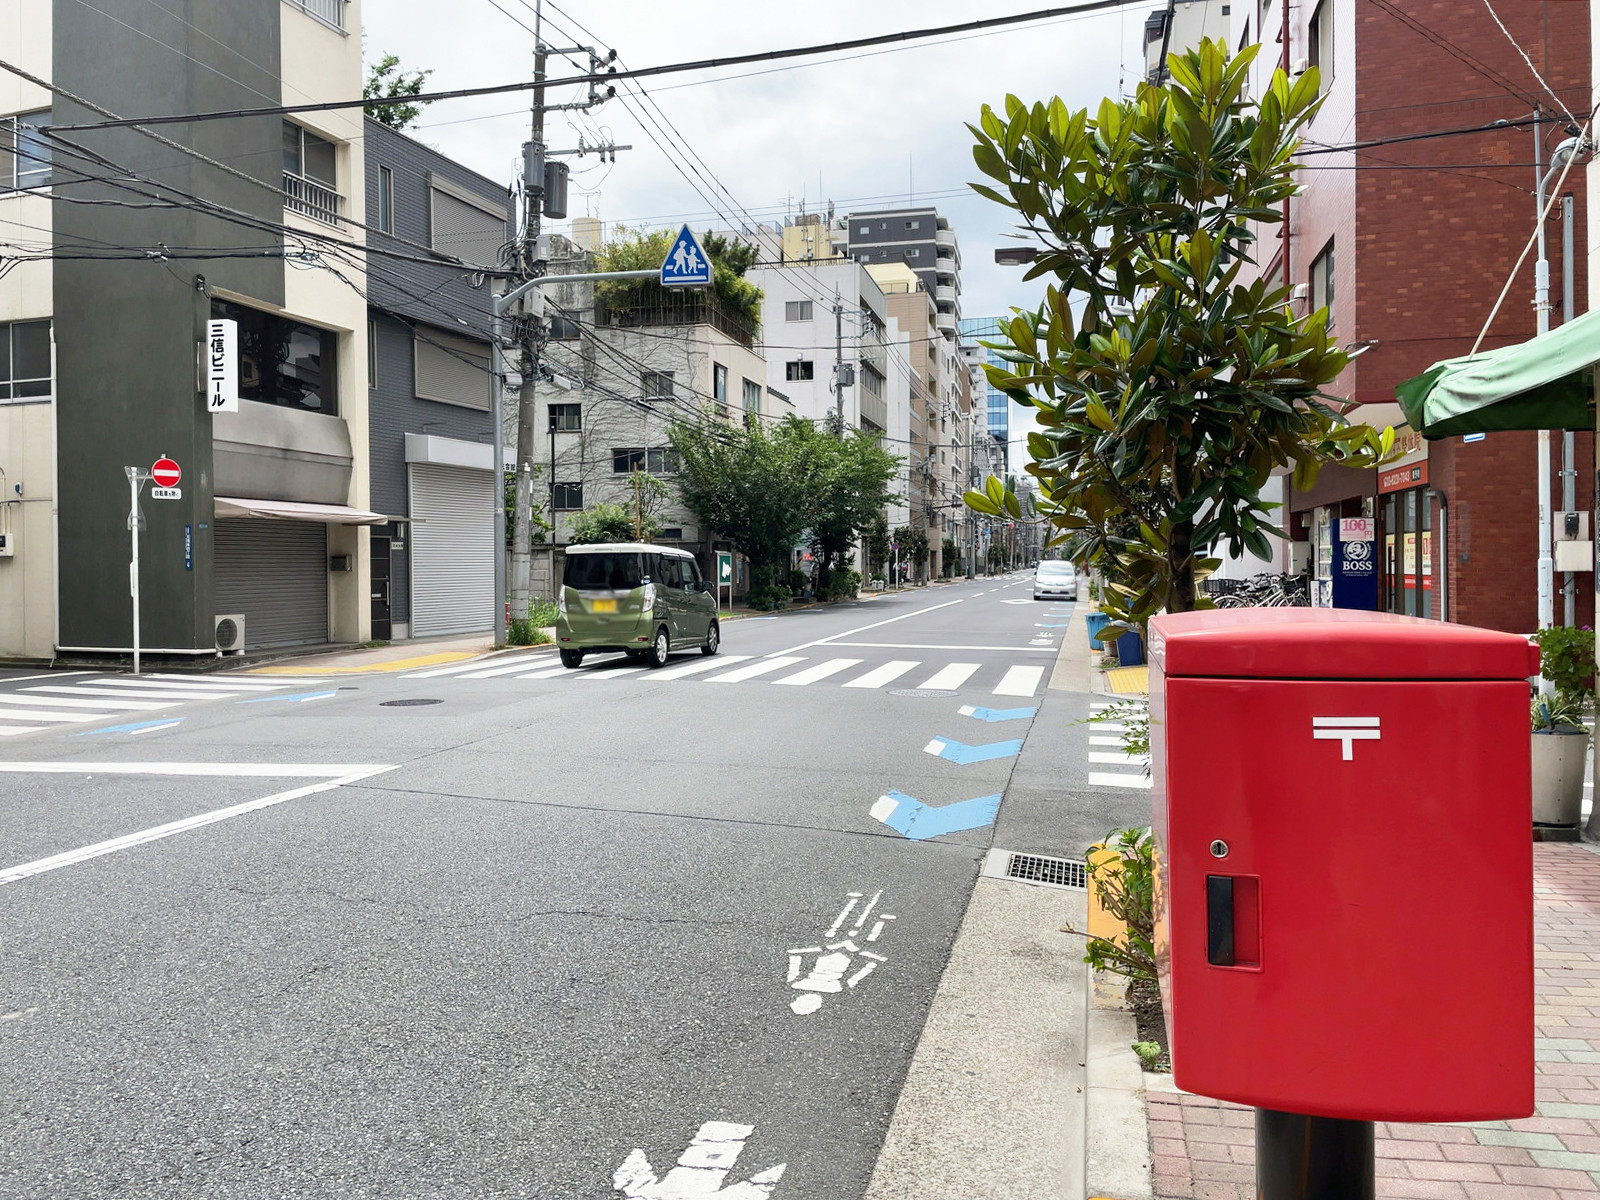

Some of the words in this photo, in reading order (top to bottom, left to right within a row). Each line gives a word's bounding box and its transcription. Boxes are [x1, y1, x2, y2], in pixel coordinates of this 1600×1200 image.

[211, 324, 225, 407] 三信ビニール
[1342, 560, 1373, 571] BOSS
